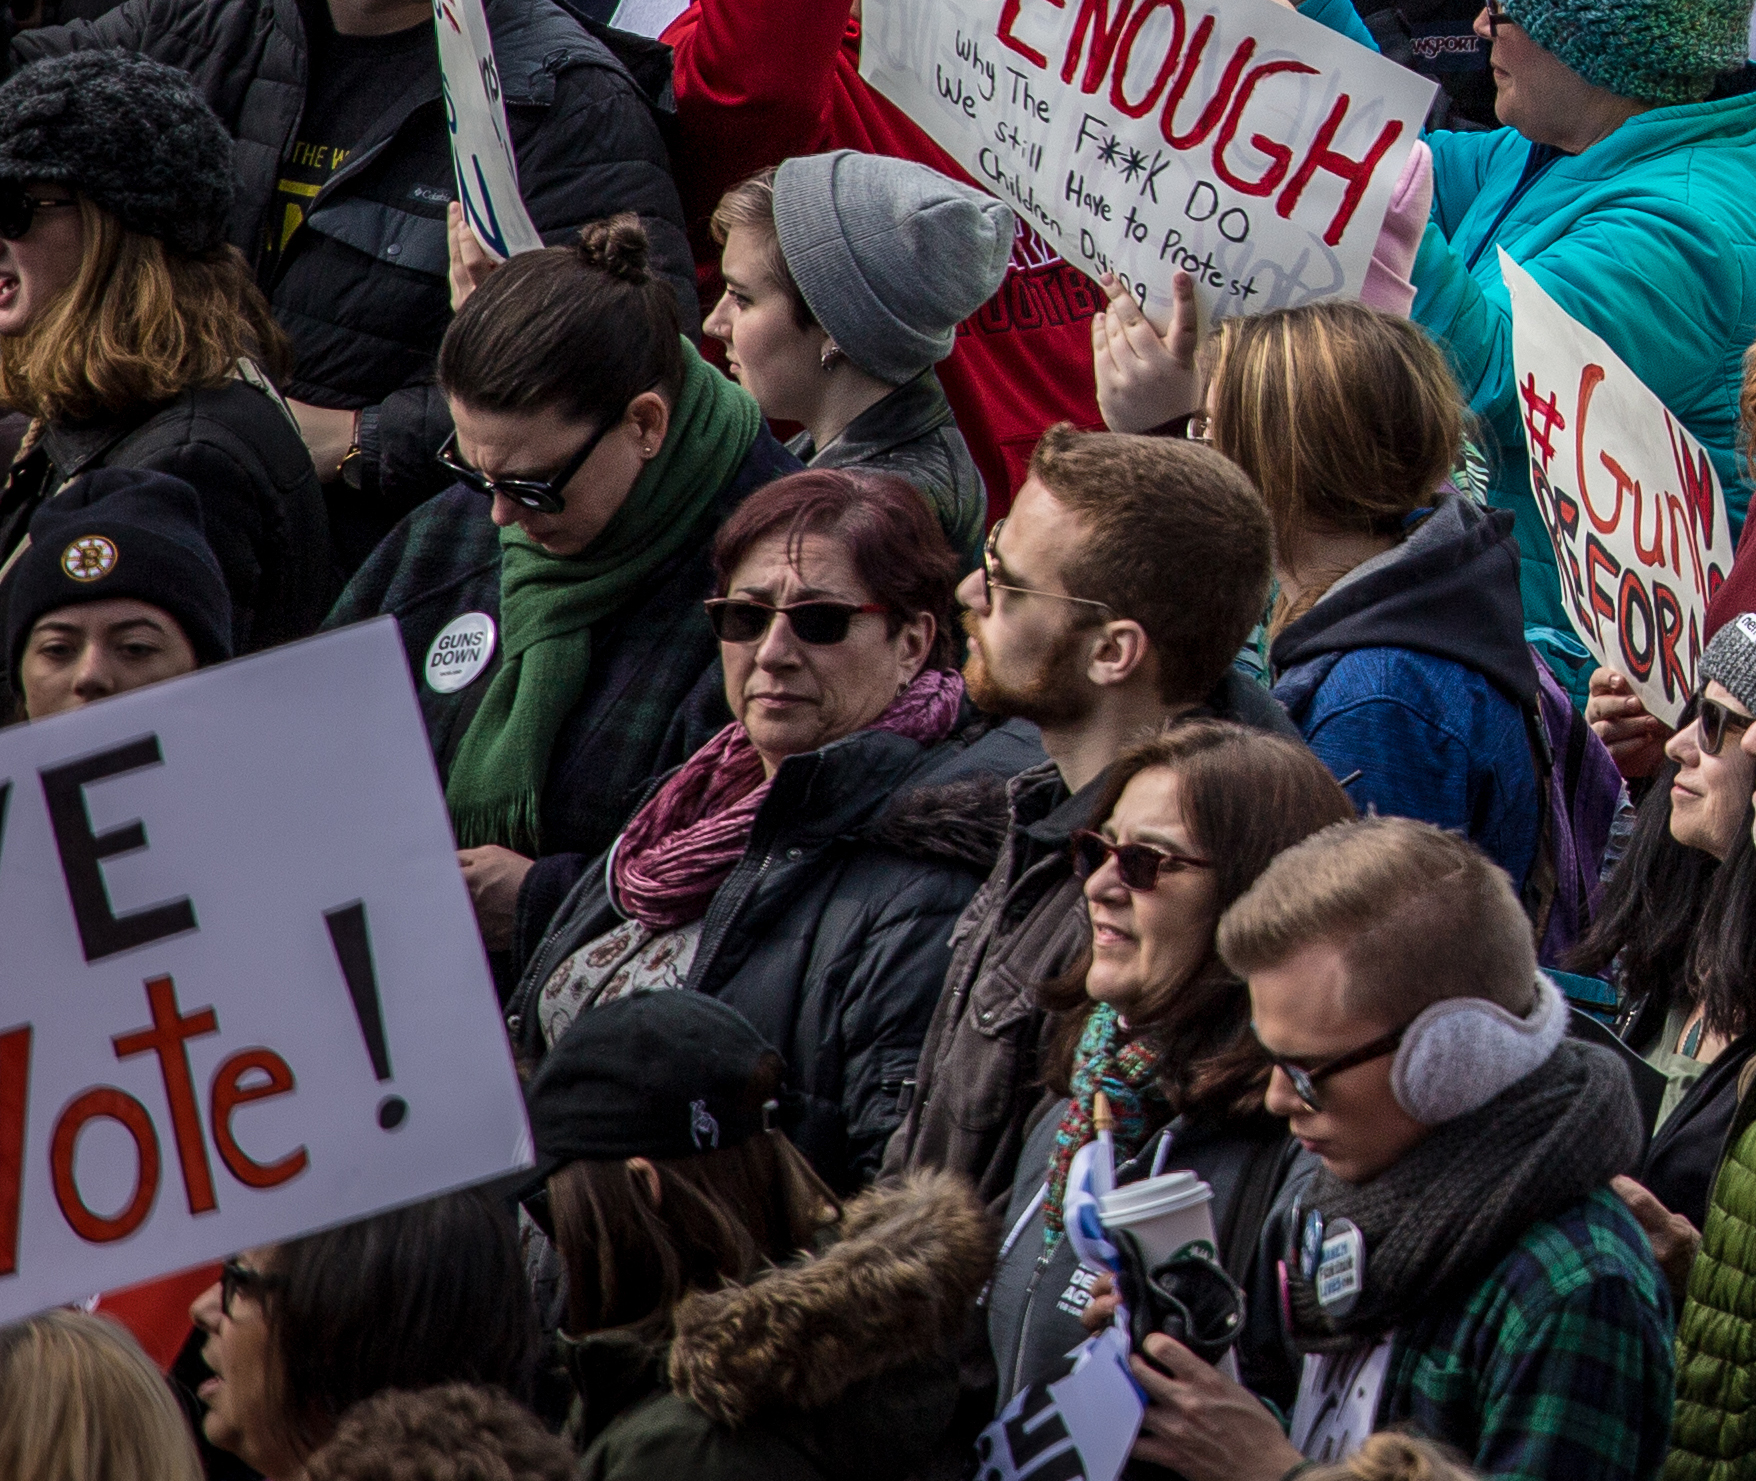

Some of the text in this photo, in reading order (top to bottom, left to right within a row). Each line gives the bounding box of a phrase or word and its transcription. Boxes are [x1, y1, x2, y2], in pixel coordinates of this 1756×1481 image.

[936, 64, 977, 120] We
[1124, 204, 1148, 244] to
[438, 631, 484, 651] GUNS
[431, 650, 481, 668] DOWN
